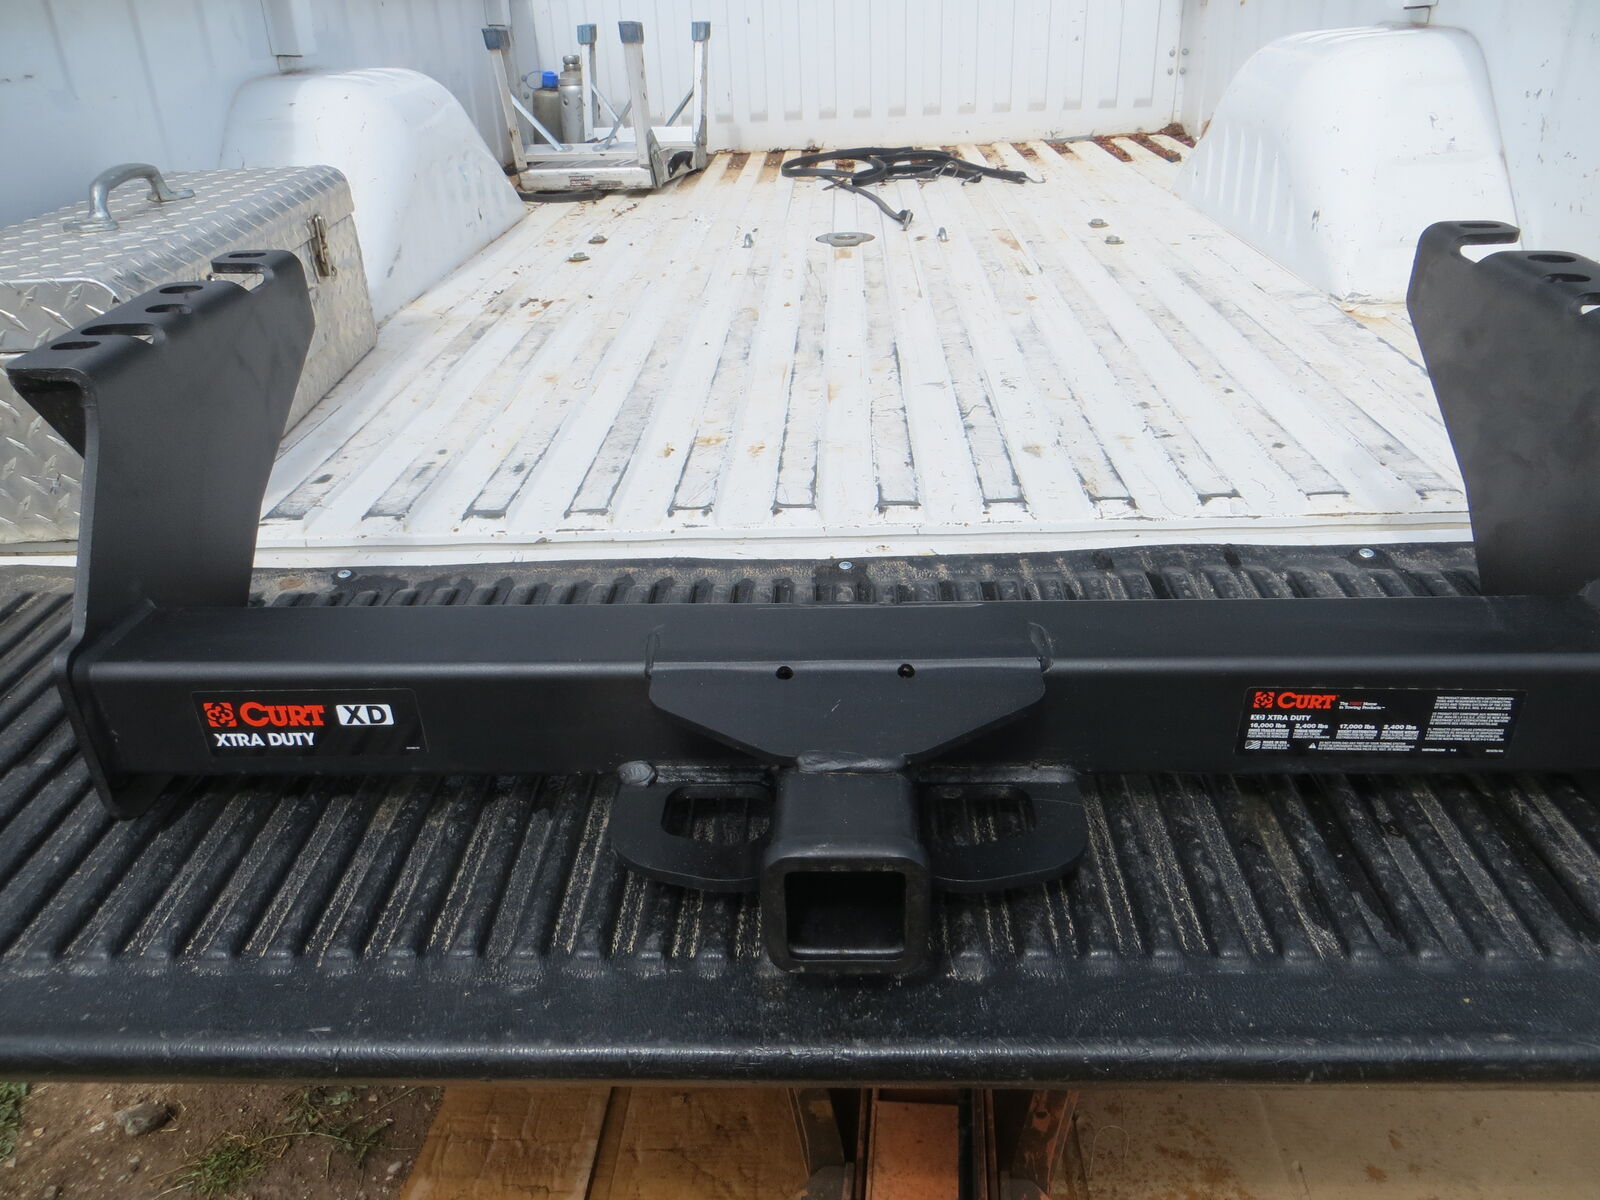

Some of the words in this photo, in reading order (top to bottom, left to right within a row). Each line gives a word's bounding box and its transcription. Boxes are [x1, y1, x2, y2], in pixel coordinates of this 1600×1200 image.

[1277, 691, 1337, 709] CURT
[239, 701, 326, 727] CURT
[343, 705, 387, 725] XD
[213, 733, 266, 747] XTRA
[267, 732, 315, 746] DUTY
